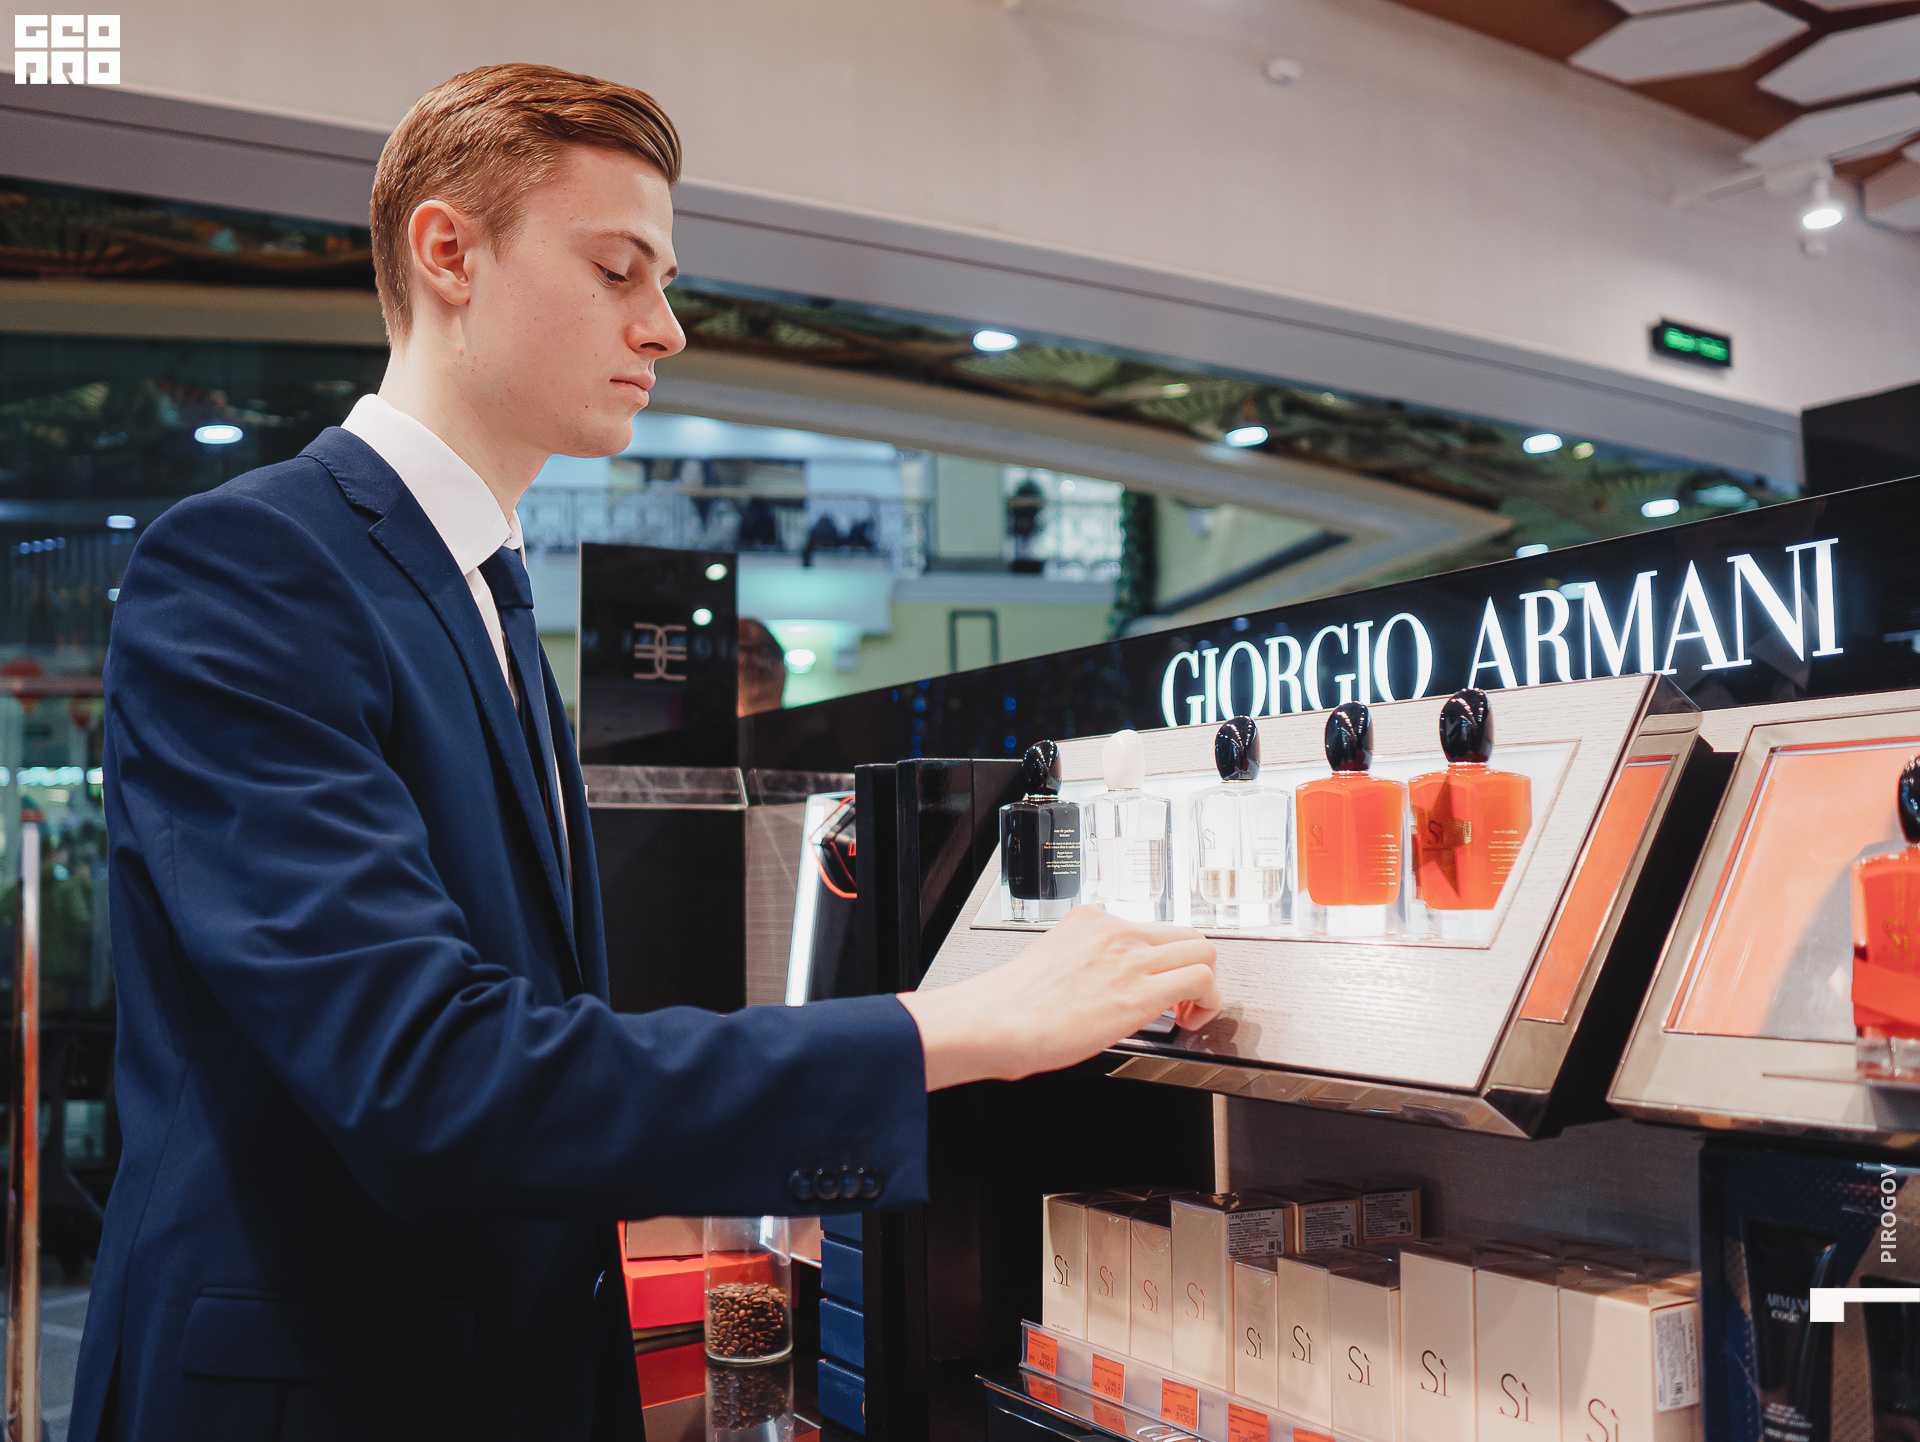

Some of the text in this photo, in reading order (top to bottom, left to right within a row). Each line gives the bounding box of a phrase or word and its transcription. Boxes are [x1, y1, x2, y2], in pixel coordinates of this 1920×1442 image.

[1161, 536, 1845, 728] GIORGIO ARMANI
[1053, 1254, 1070, 1287] Sì
[1098, 1265, 1115, 1299] Sì
[1142, 1279, 1160, 1313] Sì
[1185, 1282, 1208, 1321] Sì
[1245, 1326, 1264, 1360] Sì
[1292, 1325, 1314, 1365] Sì
[1347, 1345, 1374, 1387] Sì
[1420, 1350, 1451, 1398] Sì
[1175, 1411, 1191, 1424] 5130
[1499, 1373, 1533, 1424] Sì
[1586, 1398, 1622, 1442] Sì
